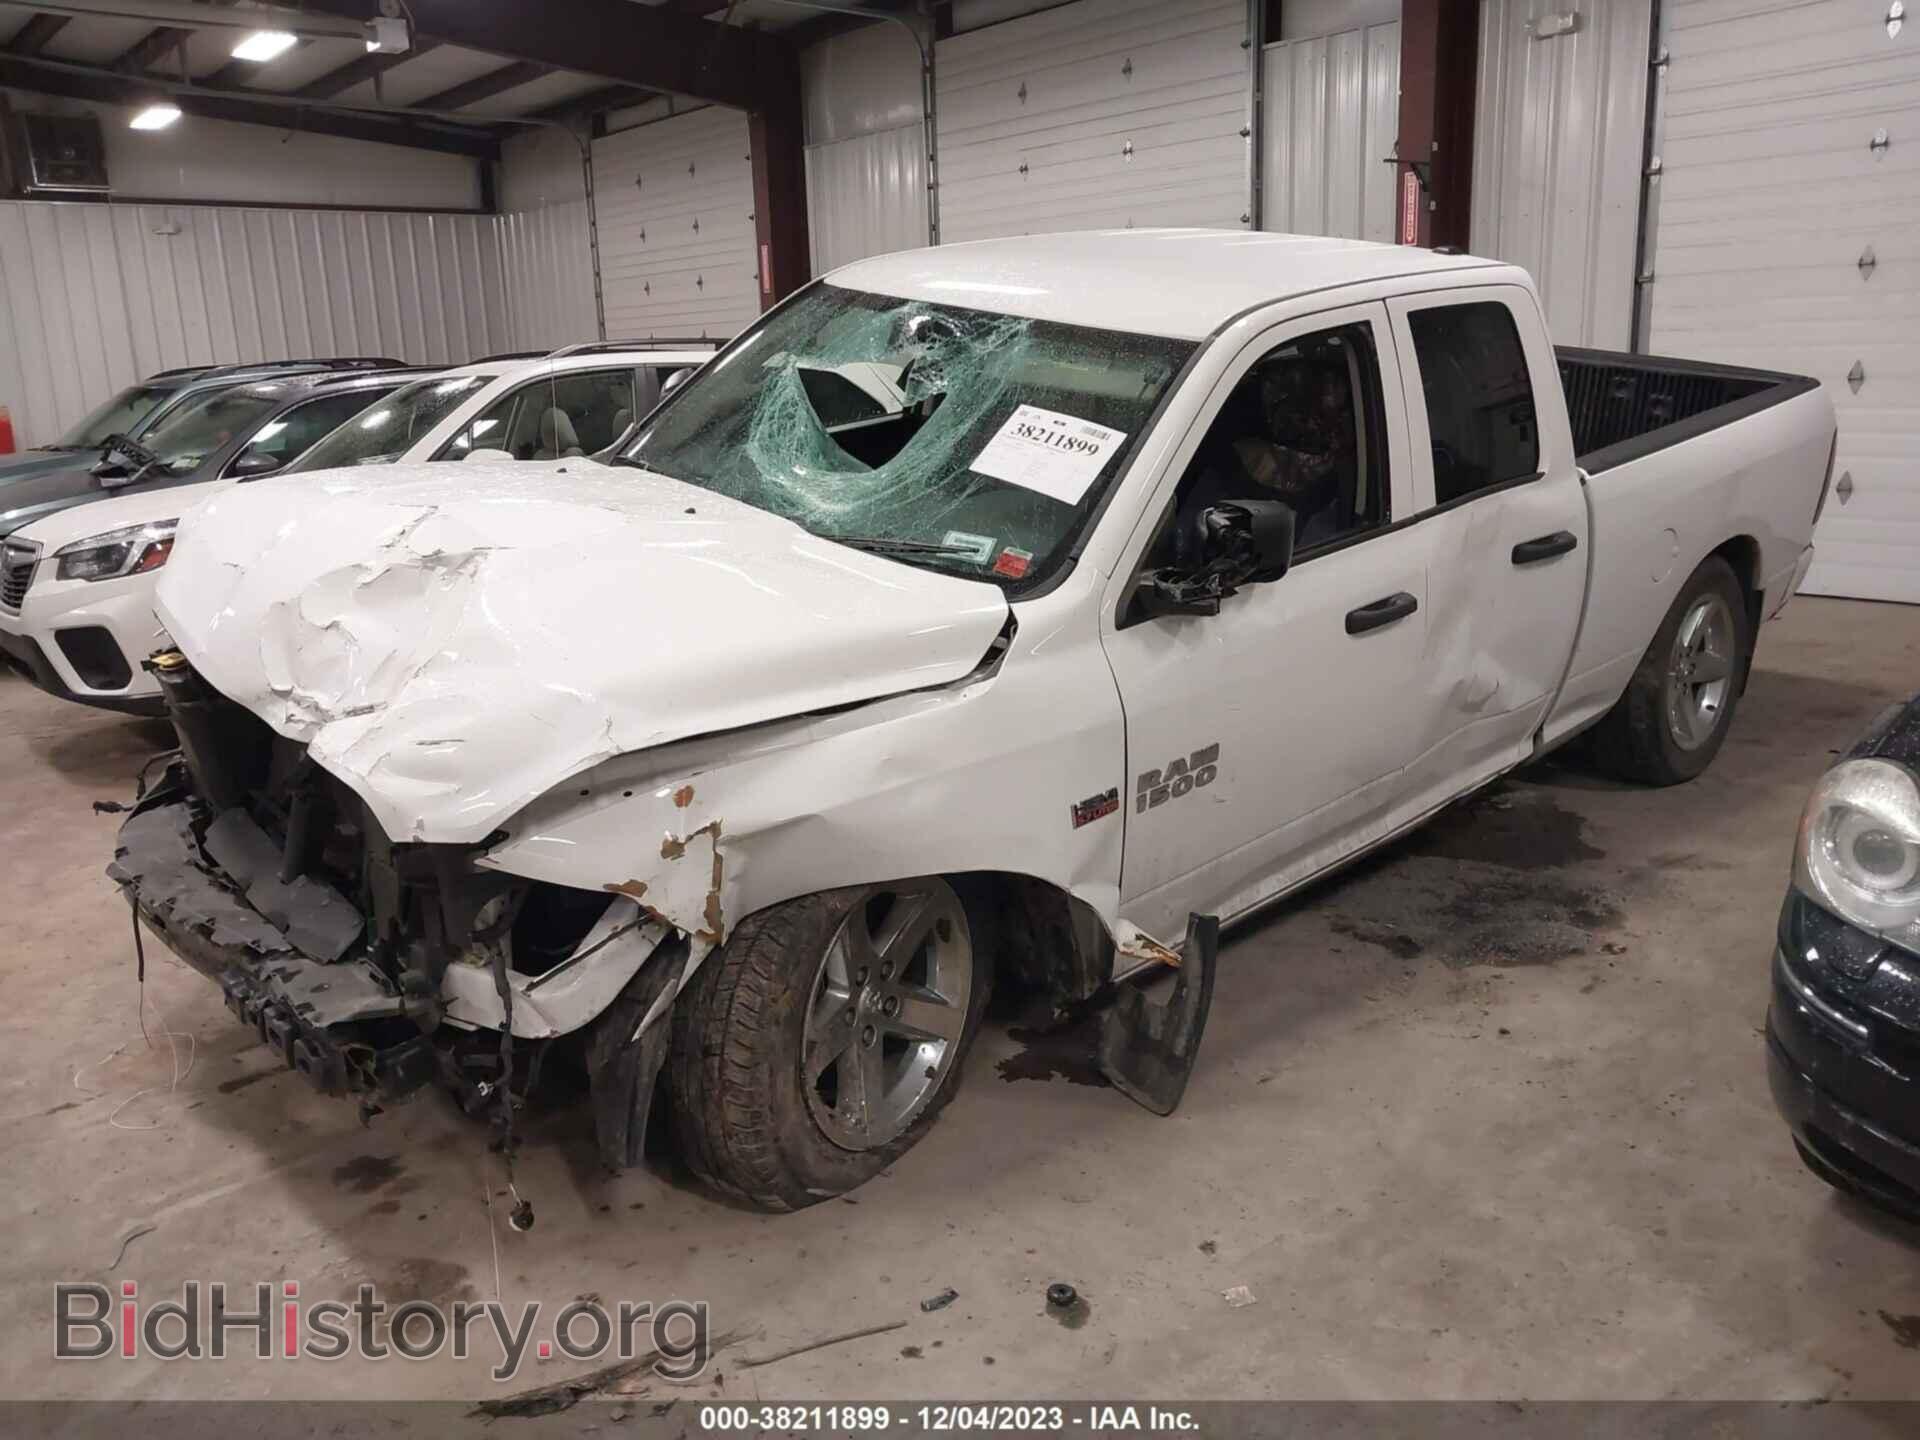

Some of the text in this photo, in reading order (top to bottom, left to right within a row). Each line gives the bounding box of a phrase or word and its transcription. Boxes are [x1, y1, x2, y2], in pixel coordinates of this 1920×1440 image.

[1010, 422, 1100, 456] 38211899
[1135, 764, 1217, 814] 1500
[1136, 743, 1220, 794] RAM
